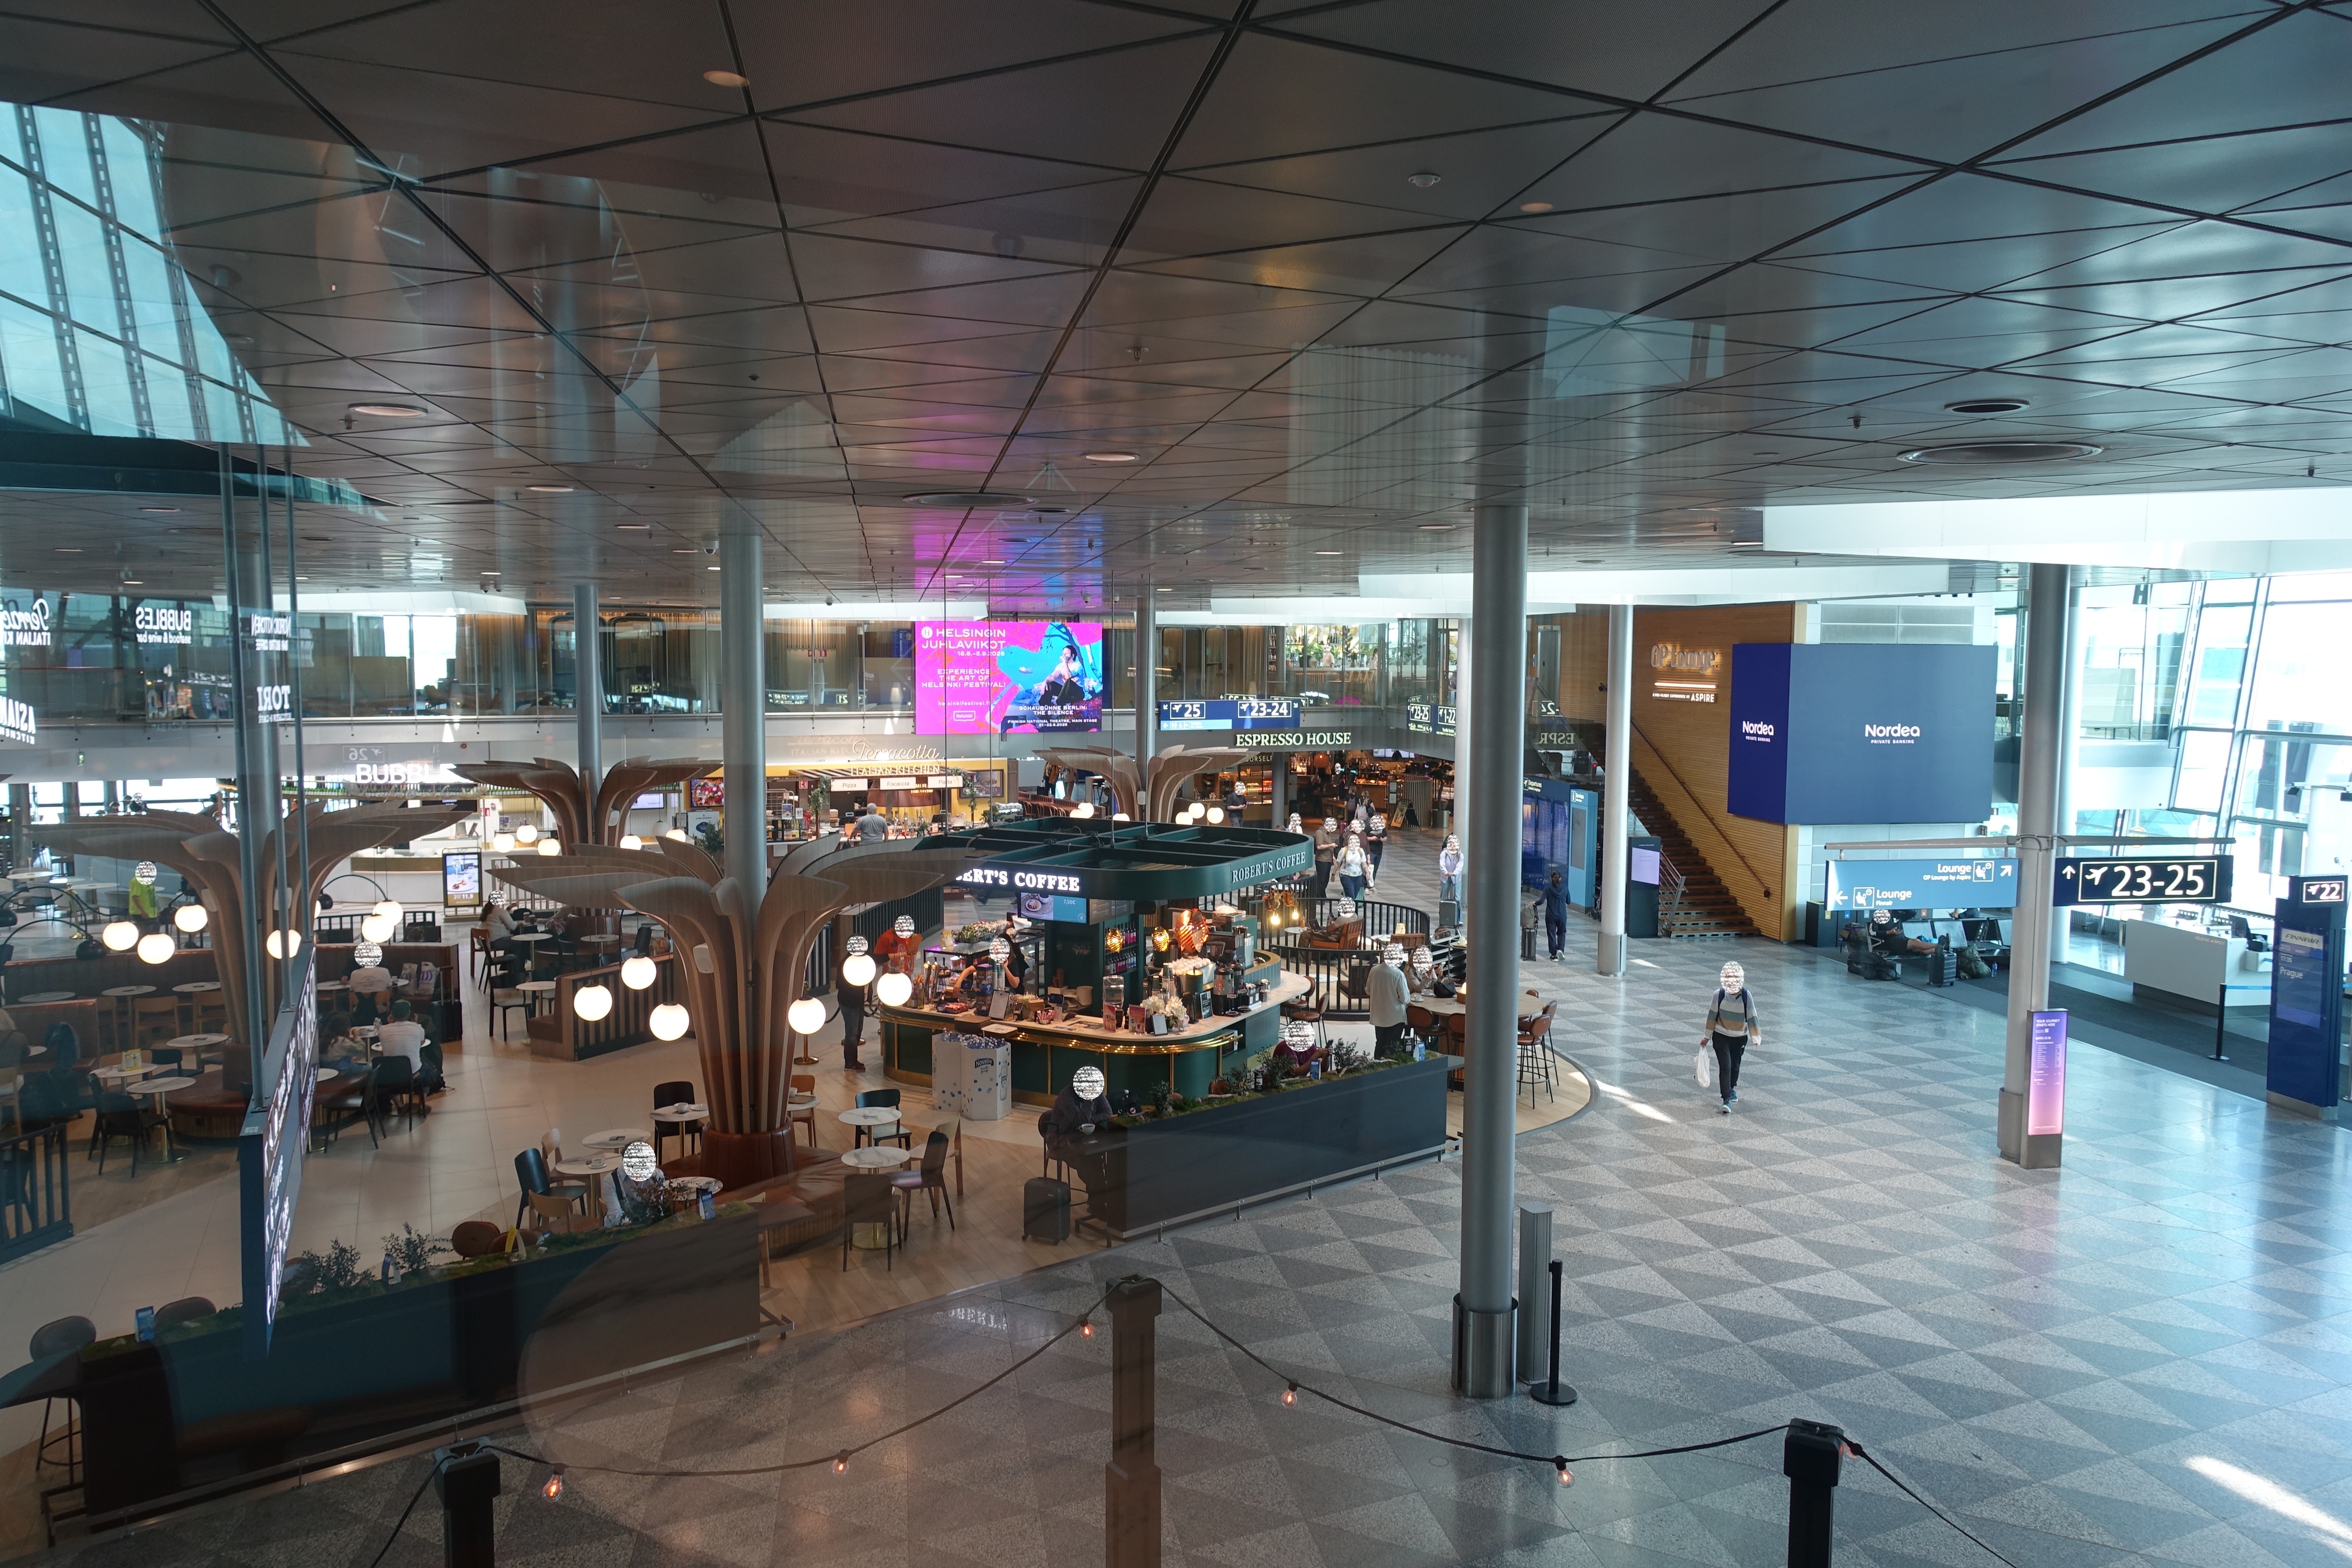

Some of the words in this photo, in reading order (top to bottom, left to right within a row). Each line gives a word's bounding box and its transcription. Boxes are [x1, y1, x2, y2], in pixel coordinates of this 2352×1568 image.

[936, 628, 1006, 637] HELSINGIN
[922, 640, 1006, 649] JUHLAVIIKOT
[1651, 645, 1668, 668] OP
[1691, 693, 1715, 702] ASPIRE
[1184, 704, 1200, 717] 25
[1250, 702, 1288, 717] 23-24
[1414, 705, 1429, 720] 23-25
[1444, 709, 1456, 724] 1-22
[1743, 720, 1774, 736] Nordea
[1865, 723, 1920, 737] Nordea
[1236, 733, 1303, 746] ESPRESSO
[1306, 732, 1351, 745] HOUSE
[852, 740, 940, 760] Terracotta
[851, 765, 892, 776] ITALIAN
[895, 764, 940, 775] KITCHEN
[1232, 860, 1273, 883] ROBERT'S
[1276, 851, 1306, 871] COFFEE
[1938, 864, 1972, 875] Lounge
[1015, 872, 1080, 892] COFFEE
[2111, 865, 2205, 897] 23-25
[1877, 889, 1912, 900] Lounge
[2319, 882, 2340, 900] 22
[2285, 934, 2319, 944] FINNAIR
[2280, 966, 2303, 979] Prague
